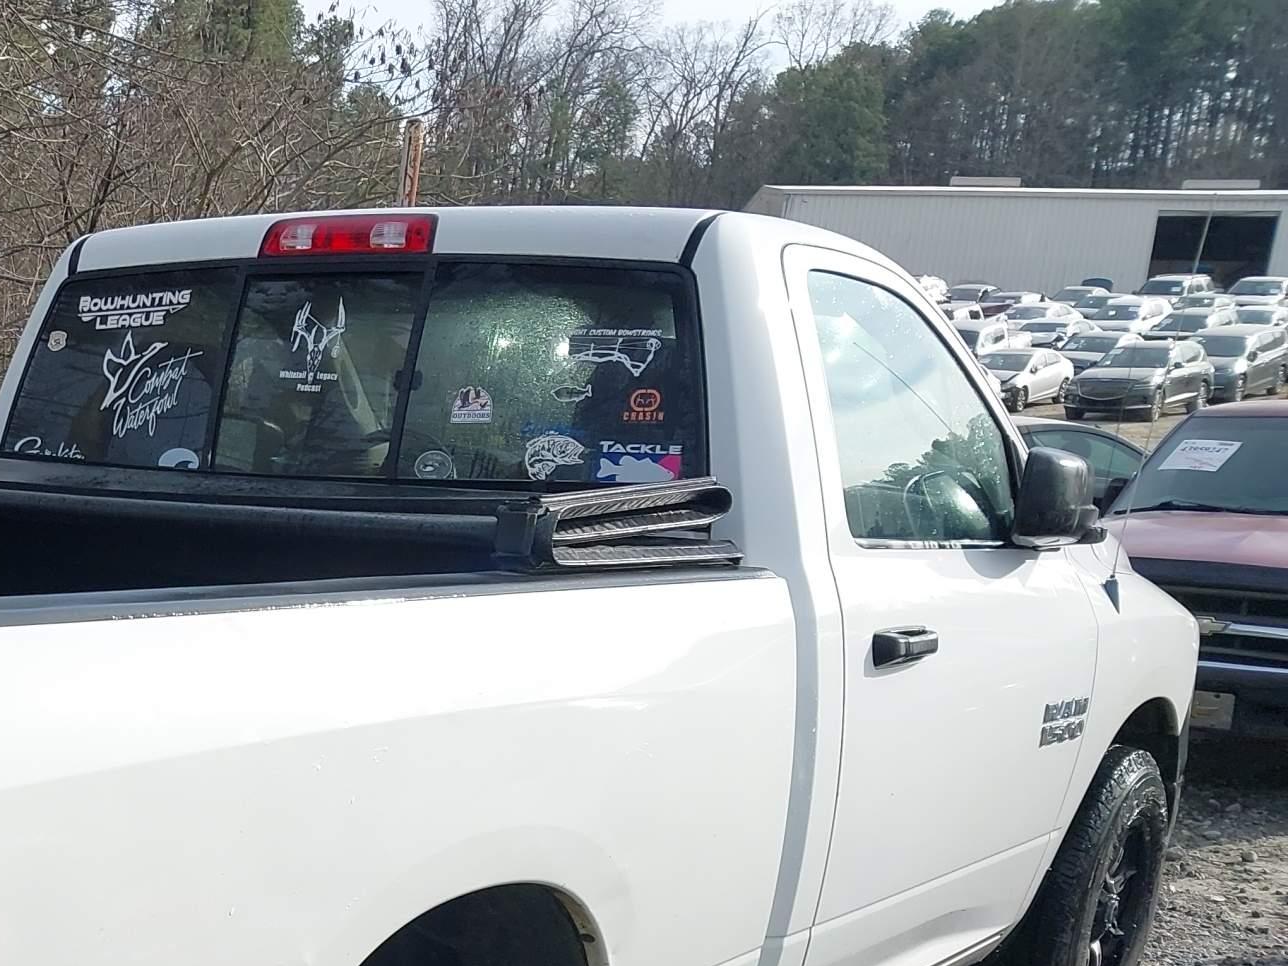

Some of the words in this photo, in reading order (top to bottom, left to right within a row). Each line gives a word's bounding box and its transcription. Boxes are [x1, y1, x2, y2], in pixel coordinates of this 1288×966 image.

[79, 289, 193, 316] BOWHUNTING
[95, 311, 167, 330] LEAGUE
[589, 328, 616, 336] CUSTOM
[617, 328, 663, 337] BOWSTRINGS
[127, 347, 204, 404] Combat
[279, 370, 307, 379] Whitetail
[316, 371, 339, 380] Legacy
[296, 383, 322, 392] Podcast
[112, 376, 184, 438] Waterfowl
[599, 440, 684, 455] TACKLE
